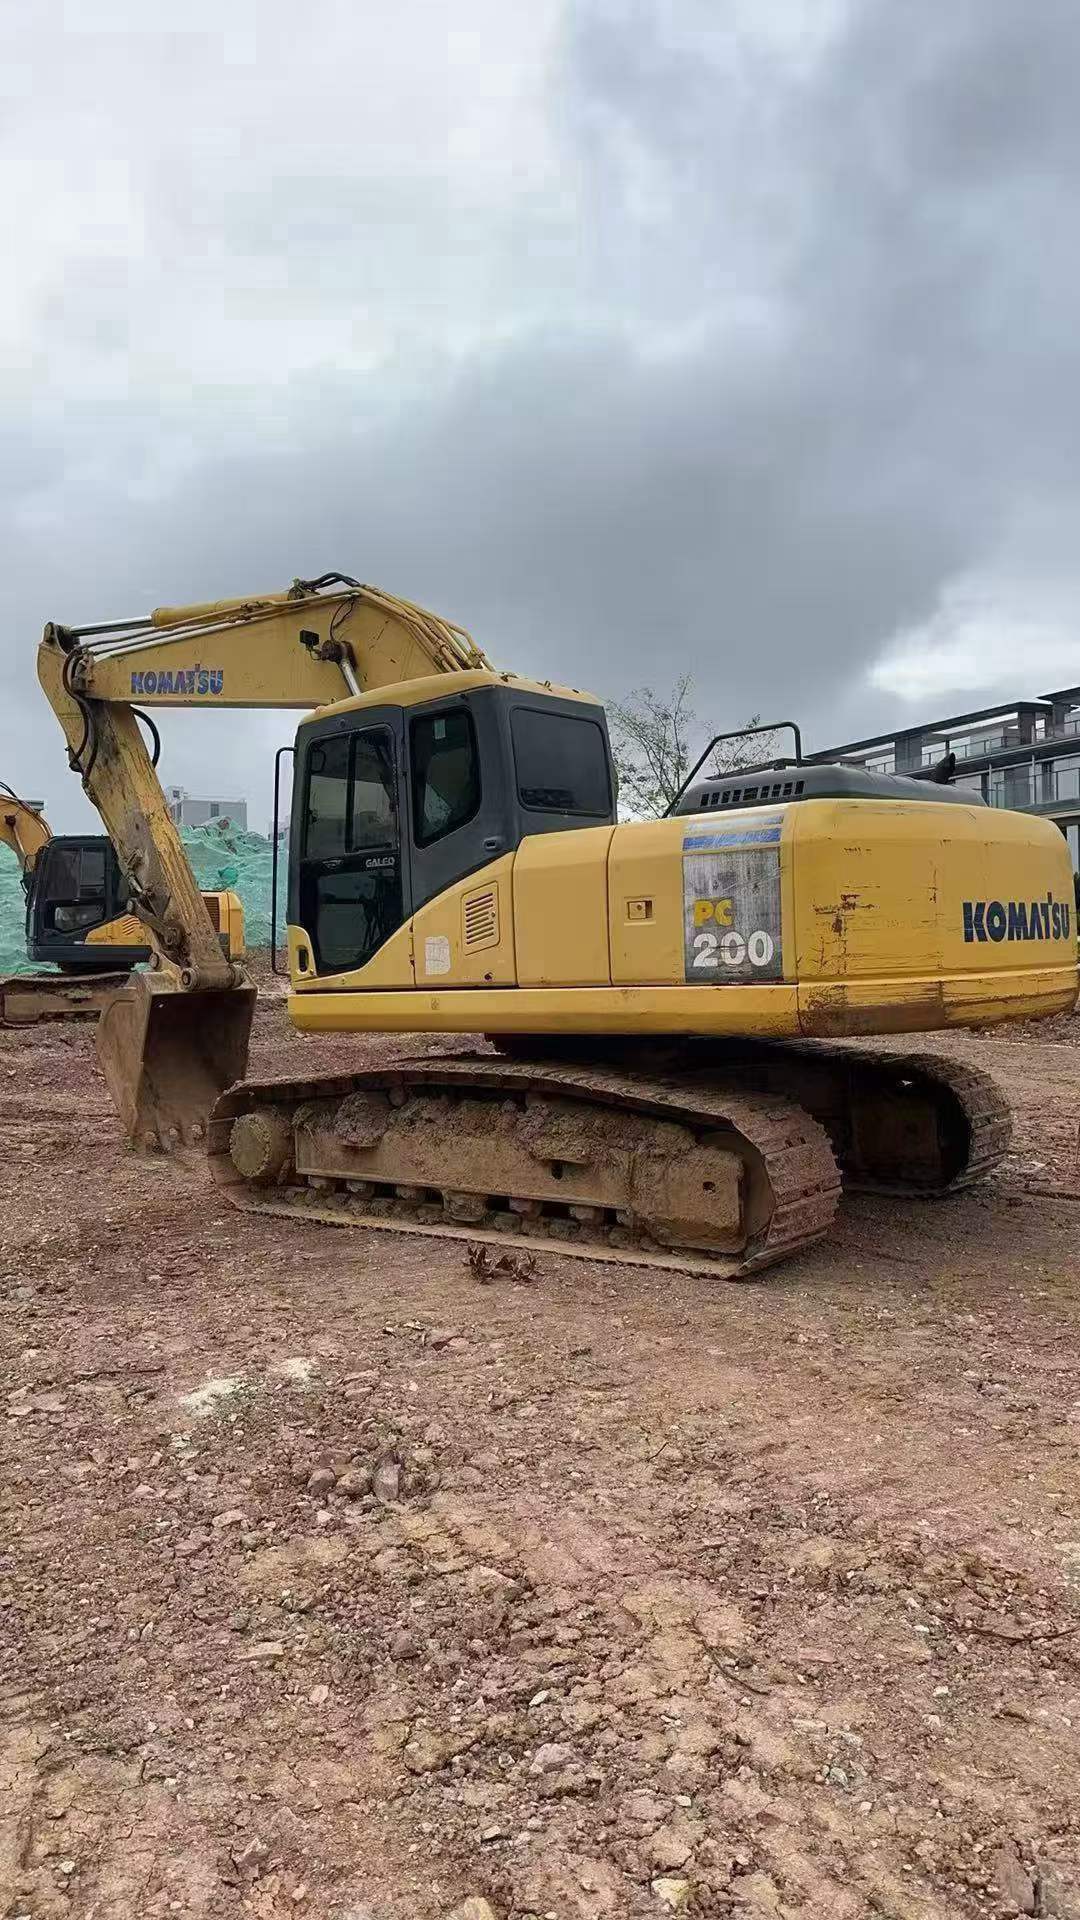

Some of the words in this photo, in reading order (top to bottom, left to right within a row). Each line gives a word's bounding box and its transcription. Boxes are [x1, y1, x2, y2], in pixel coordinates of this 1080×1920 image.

[131, 664, 223, 694] KOMATSU
[365, 857, 395, 868] GALEO
[694, 899, 733, 927] PC
[963, 892, 1069, 942] KOMATSU
[693, 930, 774, 967] 200
